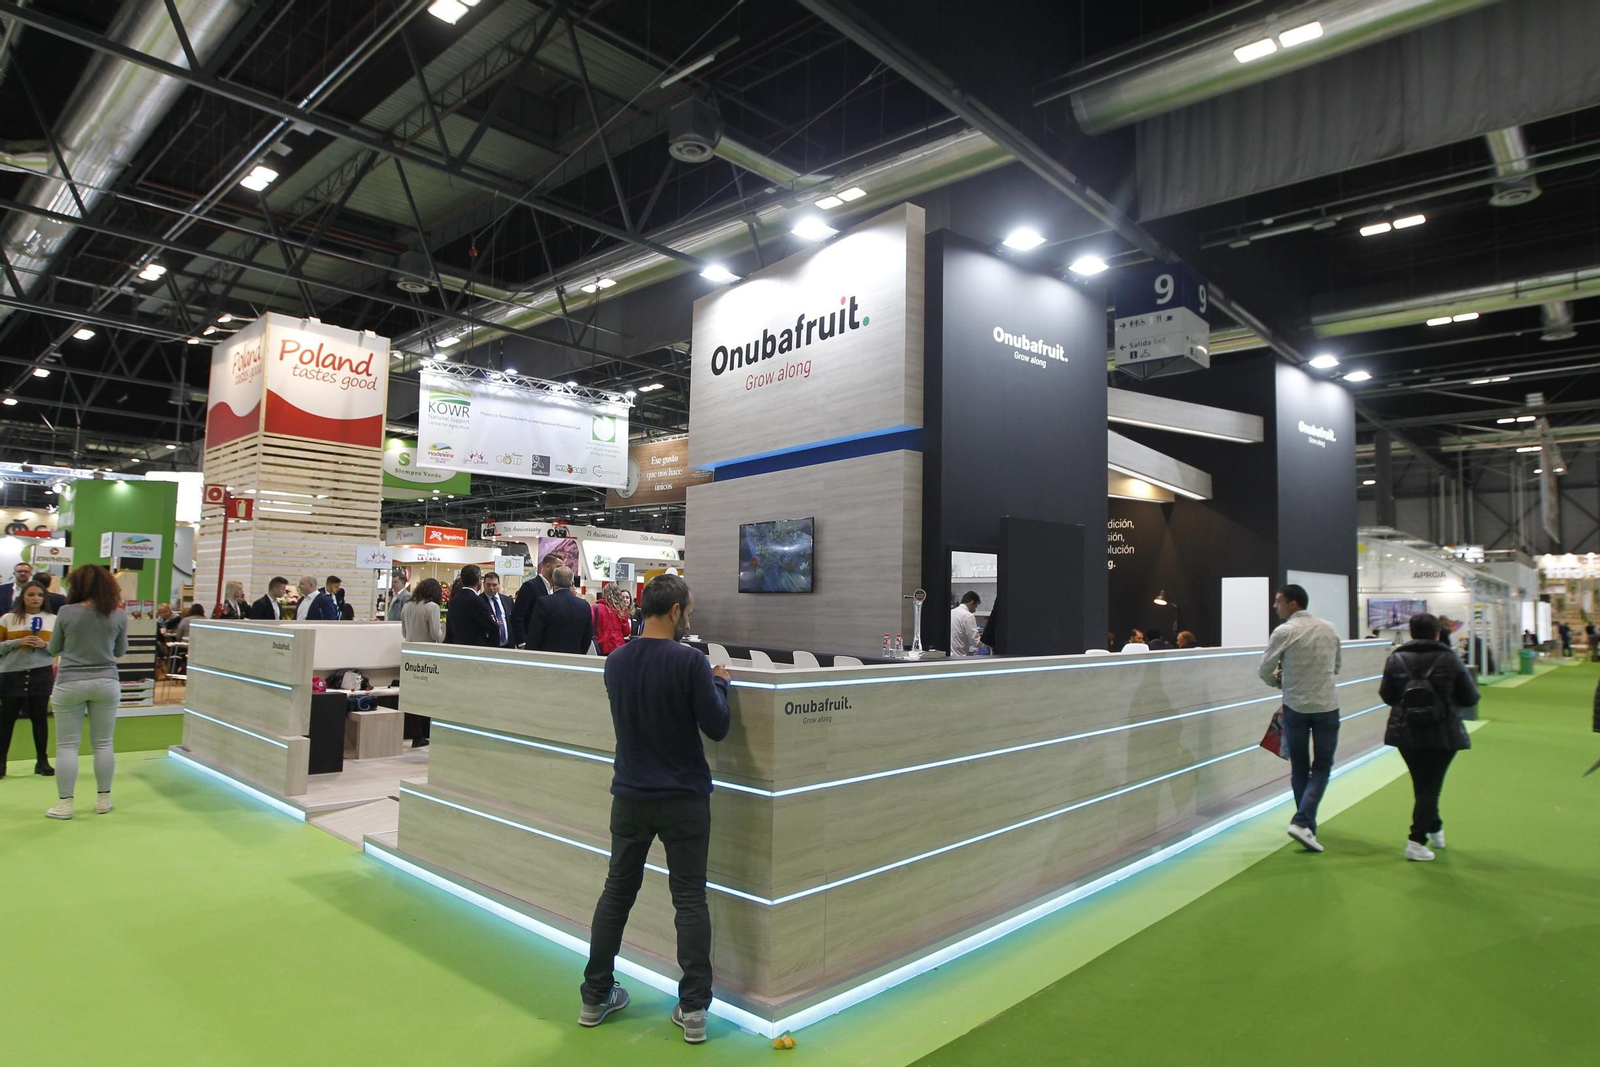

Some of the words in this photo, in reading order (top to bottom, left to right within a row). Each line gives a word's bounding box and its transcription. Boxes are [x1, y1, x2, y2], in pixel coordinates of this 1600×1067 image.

[1154, 273, 1174, 304] 9
[1198, 284, 1207, 314] 9
[711, 296, 870, 376] Onubafruit.
[993, 326, 1068, 362] Onubafruit.
[1130, 338, 1152, 348] Salida
[232, 336, 262, 376] Poland
[279, 339, 374, 377] Poland
[1014, 351, 1030, 362] Grow
[1030, 356, 1047, 369] along
[292, 364, 336, 384] tastes
[340, 376, 378, 390] good
[746, 374, 774, 391] Grow
[778, 359, 812, 382] along
[428, 401, 470, 418] KOWR
[450, 416, 470, 424] Support
[651, 457, 661, 465] Ese
[662, 455, 678, 466] gusto
[394, 468, 422, 476] Siempre
[647, 473, 657, 481] que
[668, 468, 682, 476] hace
[655, 483, 672, 491] únicos
[513, 526, 542, 534] Anniversary
[547, 528, 567, 538] CASI
[404, 662, 440, 674] Onubafruit.
[784, 696, 852, 715] Onubafruit.
[818, 715, 832, 724] along
